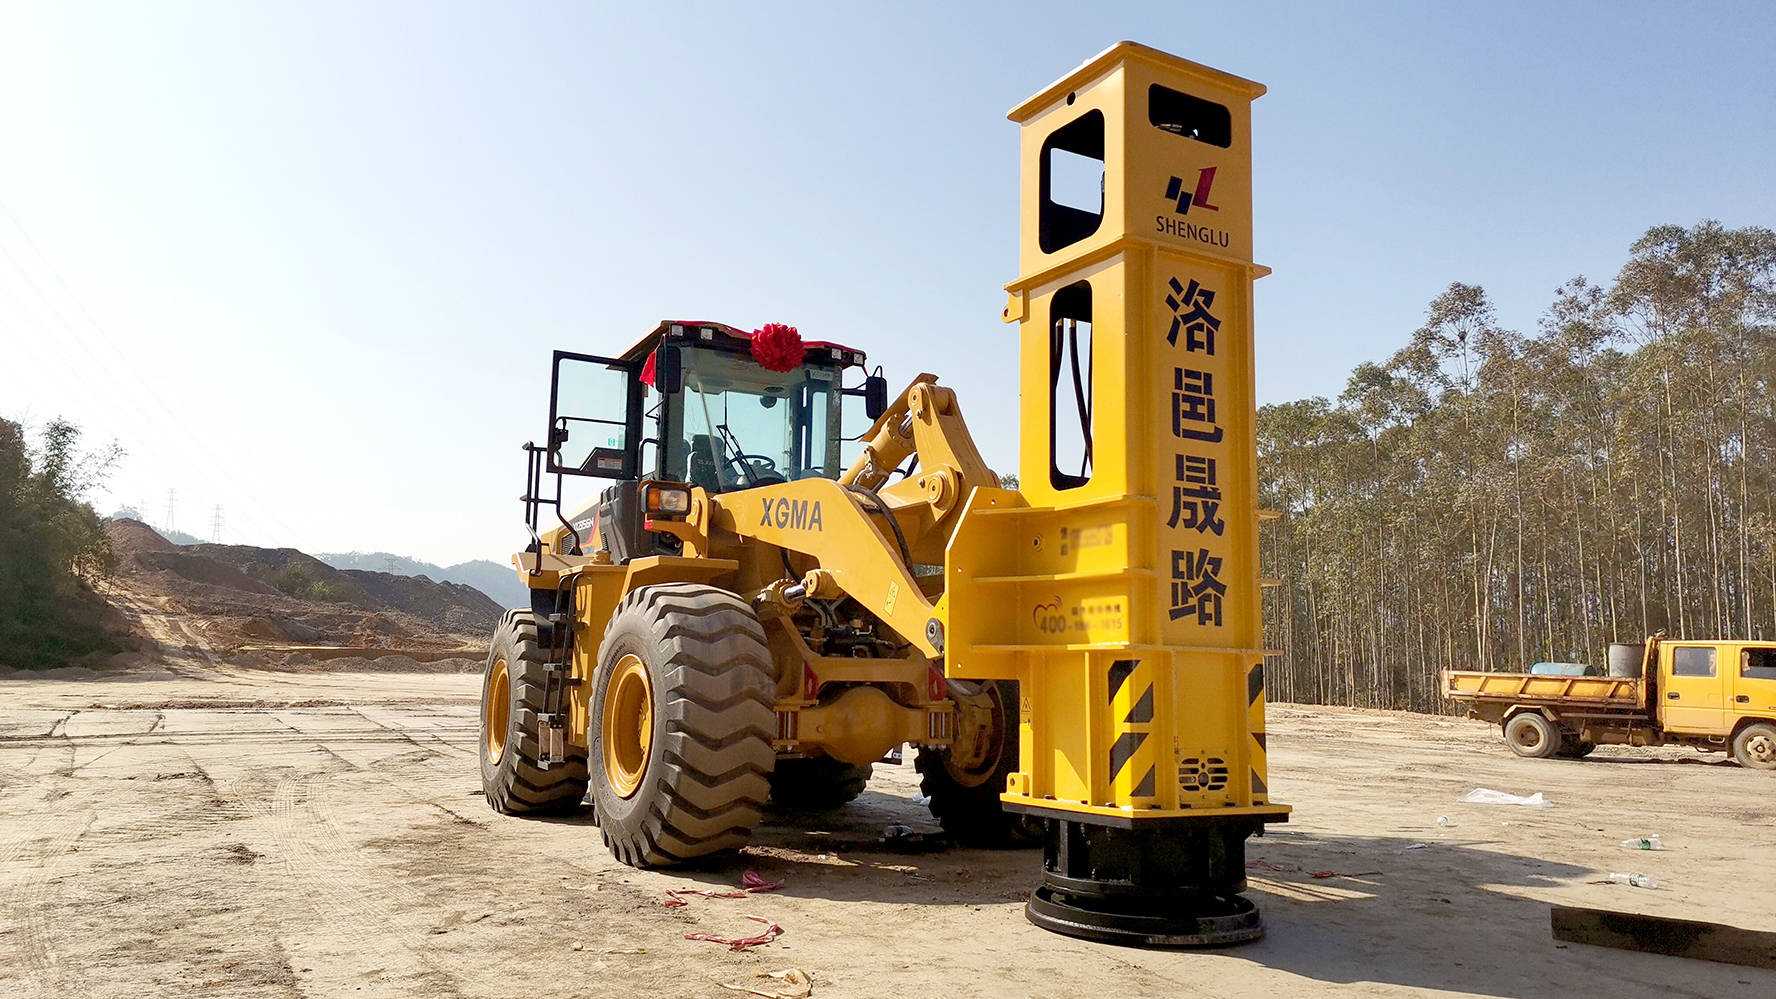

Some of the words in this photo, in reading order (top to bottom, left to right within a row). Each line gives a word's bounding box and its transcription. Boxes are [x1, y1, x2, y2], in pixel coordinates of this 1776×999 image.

[1156, 215, 1229, 248] SHENGLU
[1165, 276, 1227, 627] 洛邑晟路
[760, 497, 823, 532] XGMA
